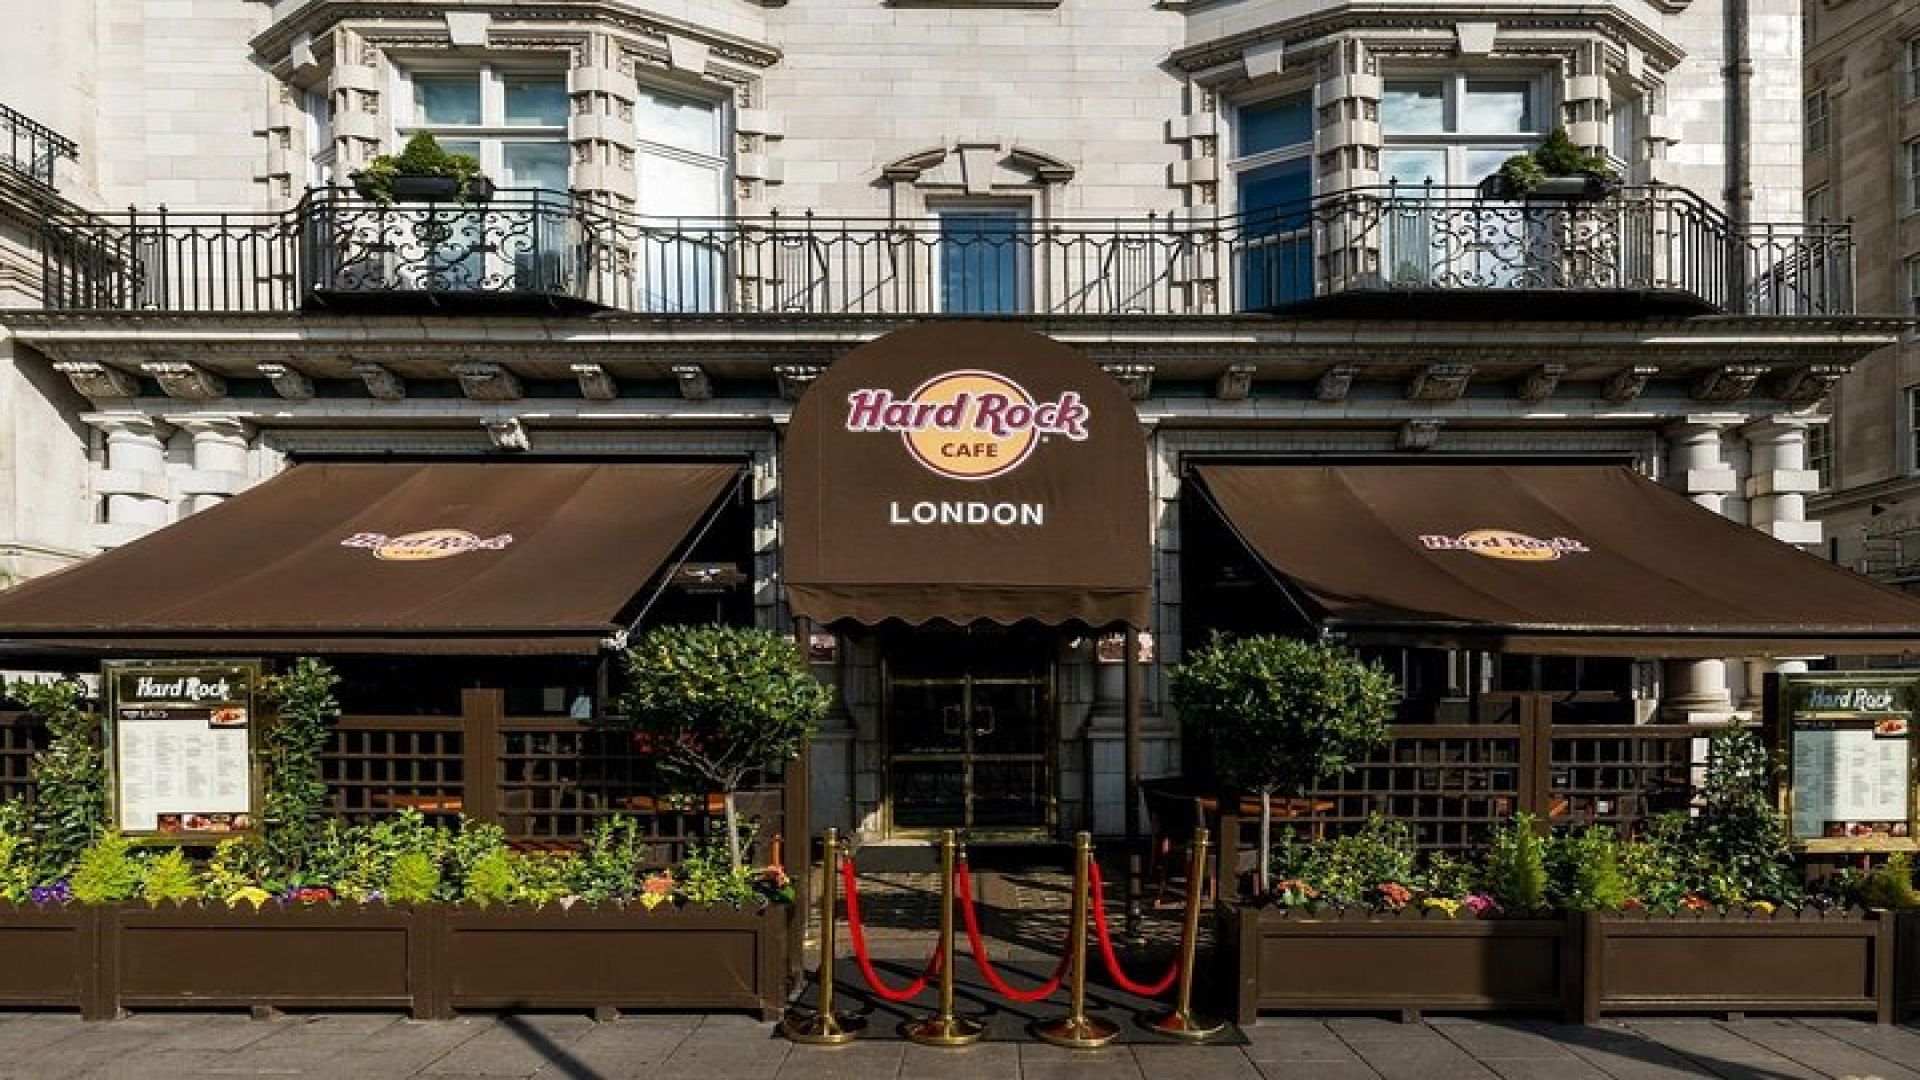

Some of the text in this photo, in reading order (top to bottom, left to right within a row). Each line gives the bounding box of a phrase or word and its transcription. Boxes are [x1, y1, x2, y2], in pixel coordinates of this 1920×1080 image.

[846, 389, 1089, 441] Hard Rock
[940, 443, 999, 458] CAFE
[890, 501, 1044, 525] LONDON
[136, 676, 231, 701] Hard Rock
[1811, 688, 1893, 712] Hard Rock
